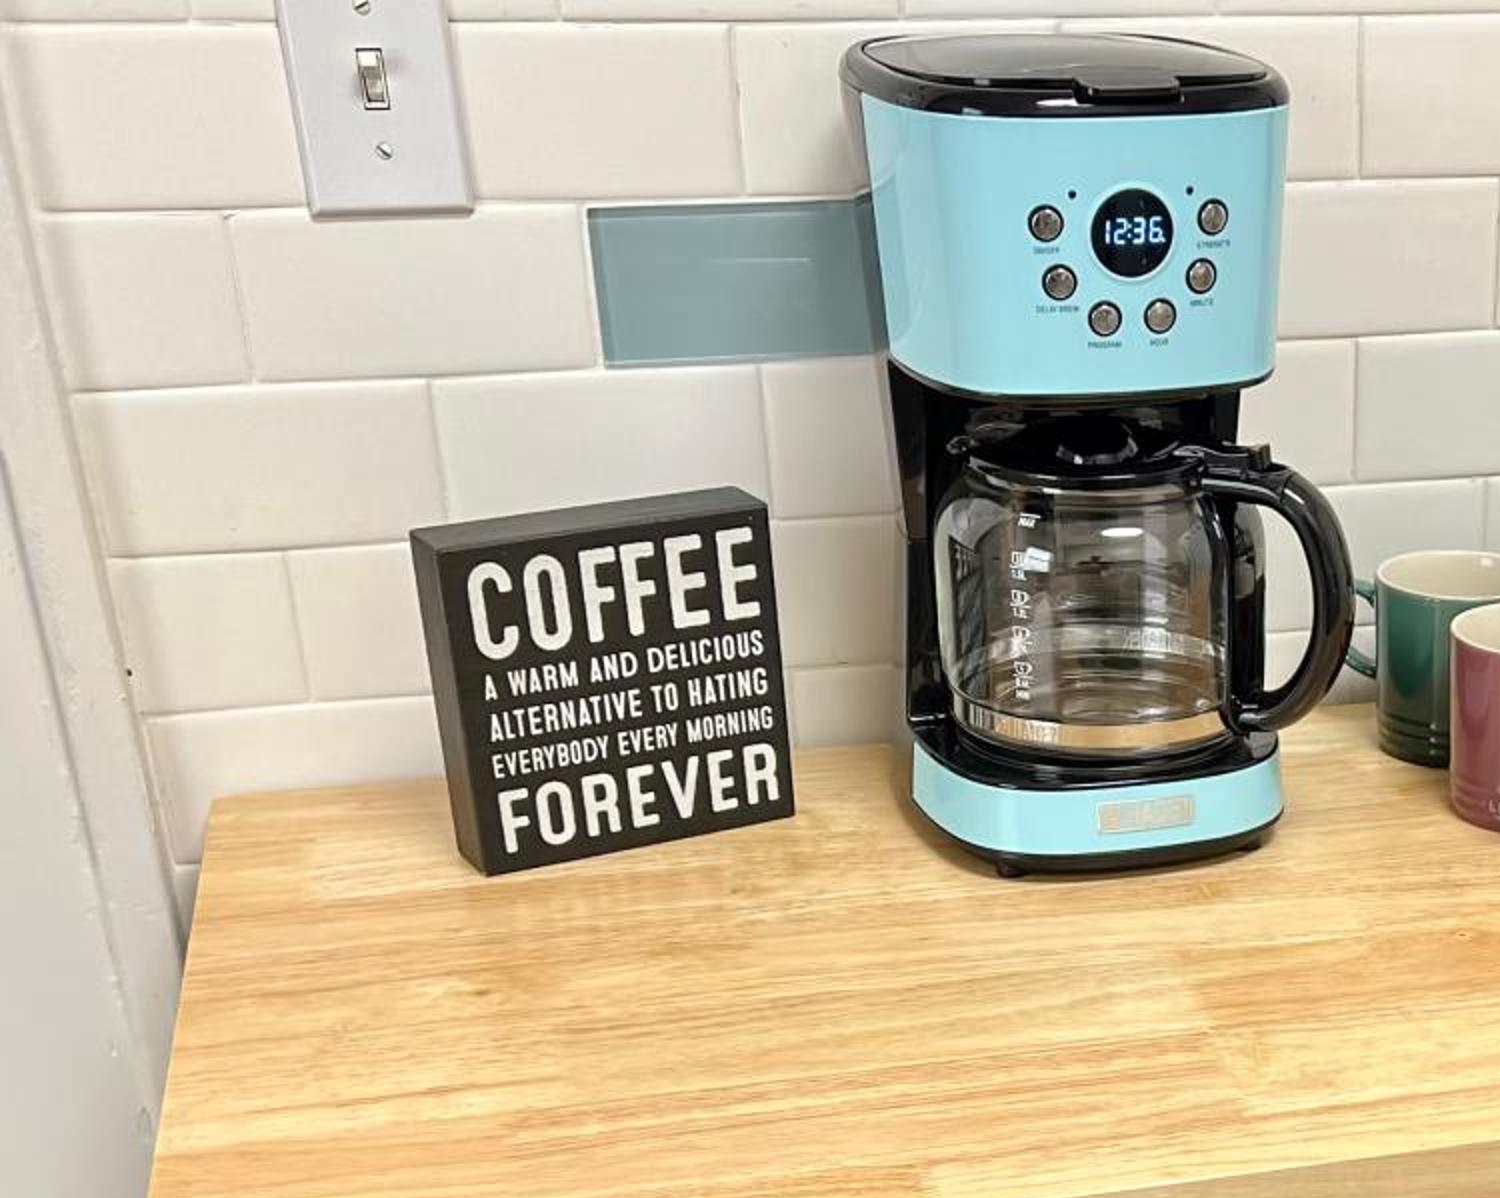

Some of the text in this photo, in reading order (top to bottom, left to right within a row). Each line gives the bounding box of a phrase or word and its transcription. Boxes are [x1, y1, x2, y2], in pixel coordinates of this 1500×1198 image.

[467, 526, 761, 660] COFFEE
[484, 629, 764, 700] A WARM AND DELICIOUS
[489, 667, 768, 743] ALTERNATIVE TO HATING
[492, 706, 774, 779] EVERYBODY EVERY MORNING
[498, 743, 780, 854] FOREVER
